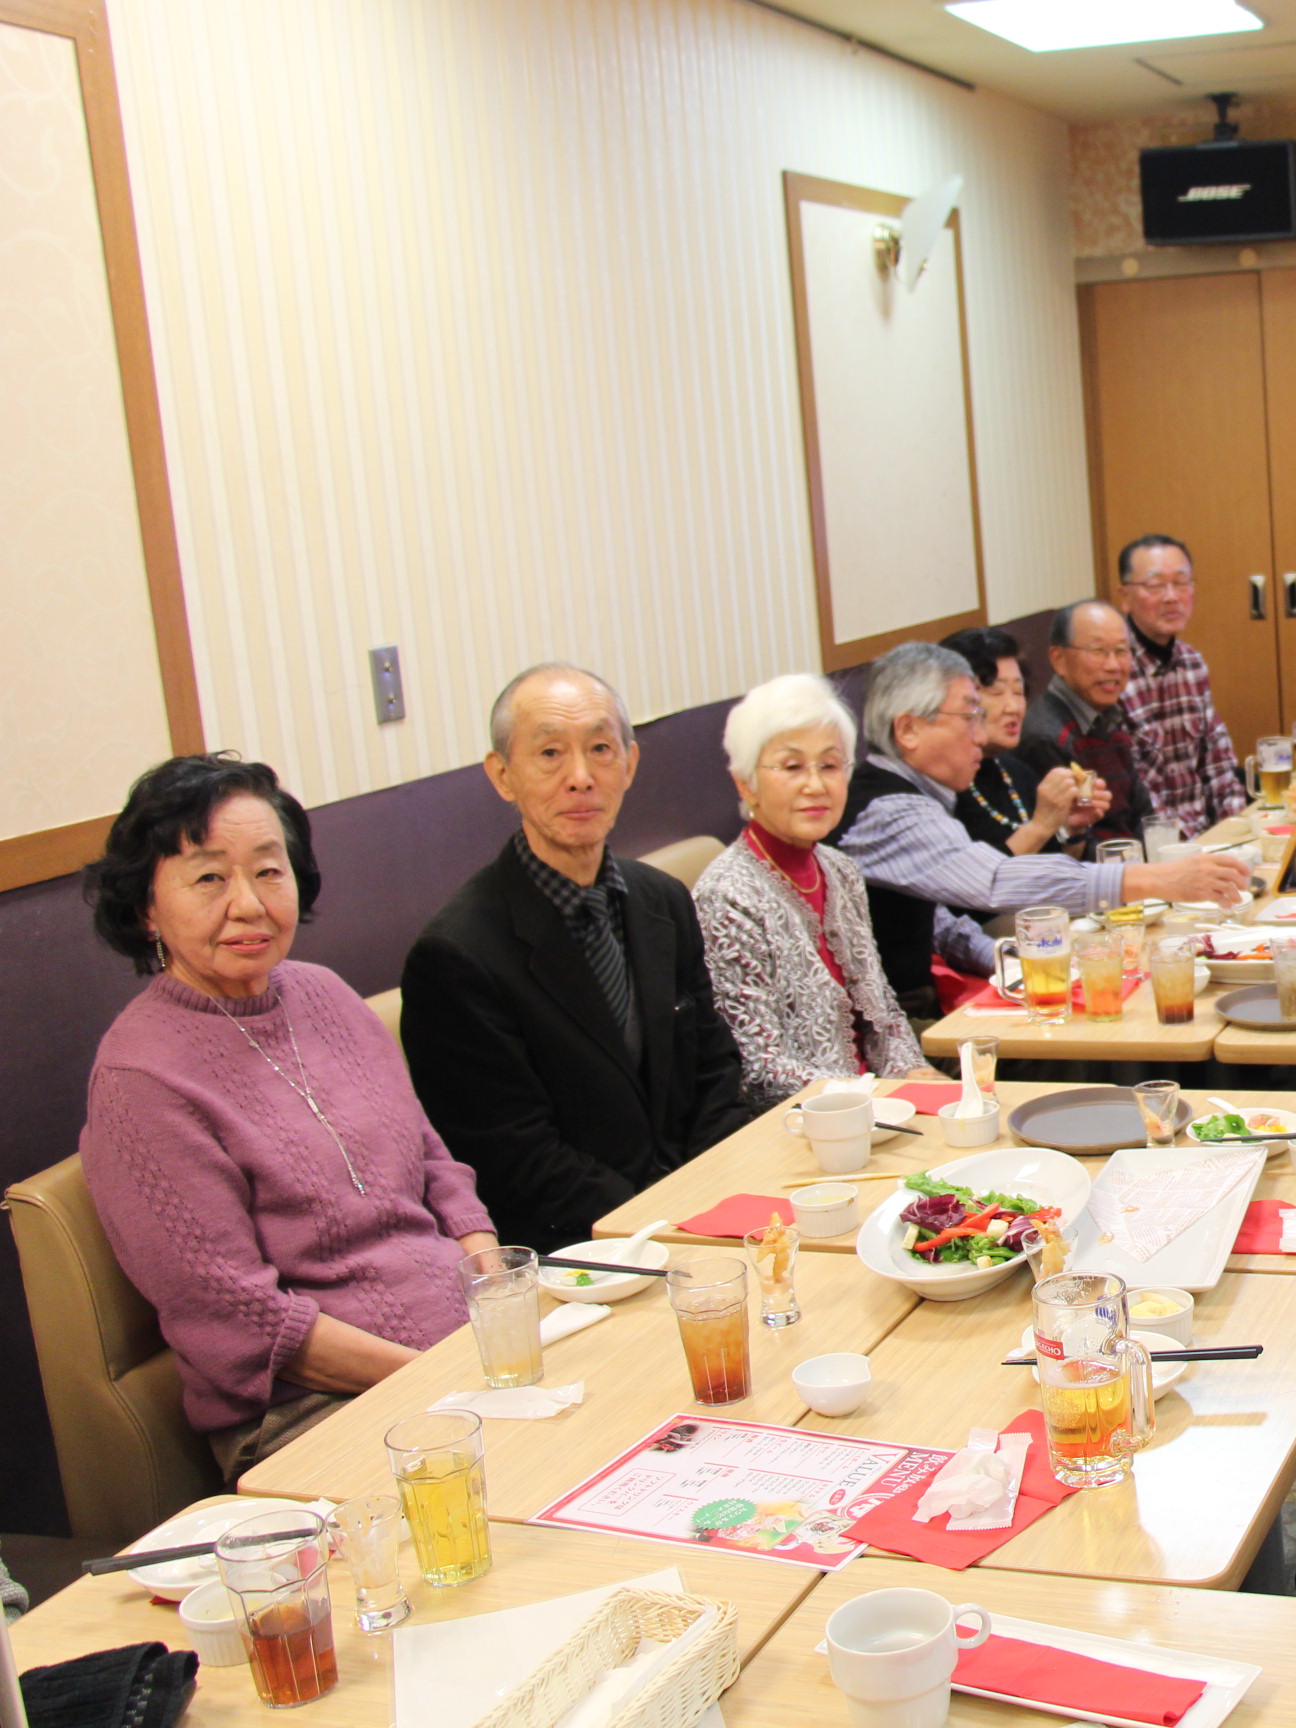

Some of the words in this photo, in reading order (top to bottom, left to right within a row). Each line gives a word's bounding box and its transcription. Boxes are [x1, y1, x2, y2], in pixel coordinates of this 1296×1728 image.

[1177, 184, 1252, 202] BOSE
[839, 1453, 899, 1488] VALUE
[881, 1452, 930, 1487] MENU
